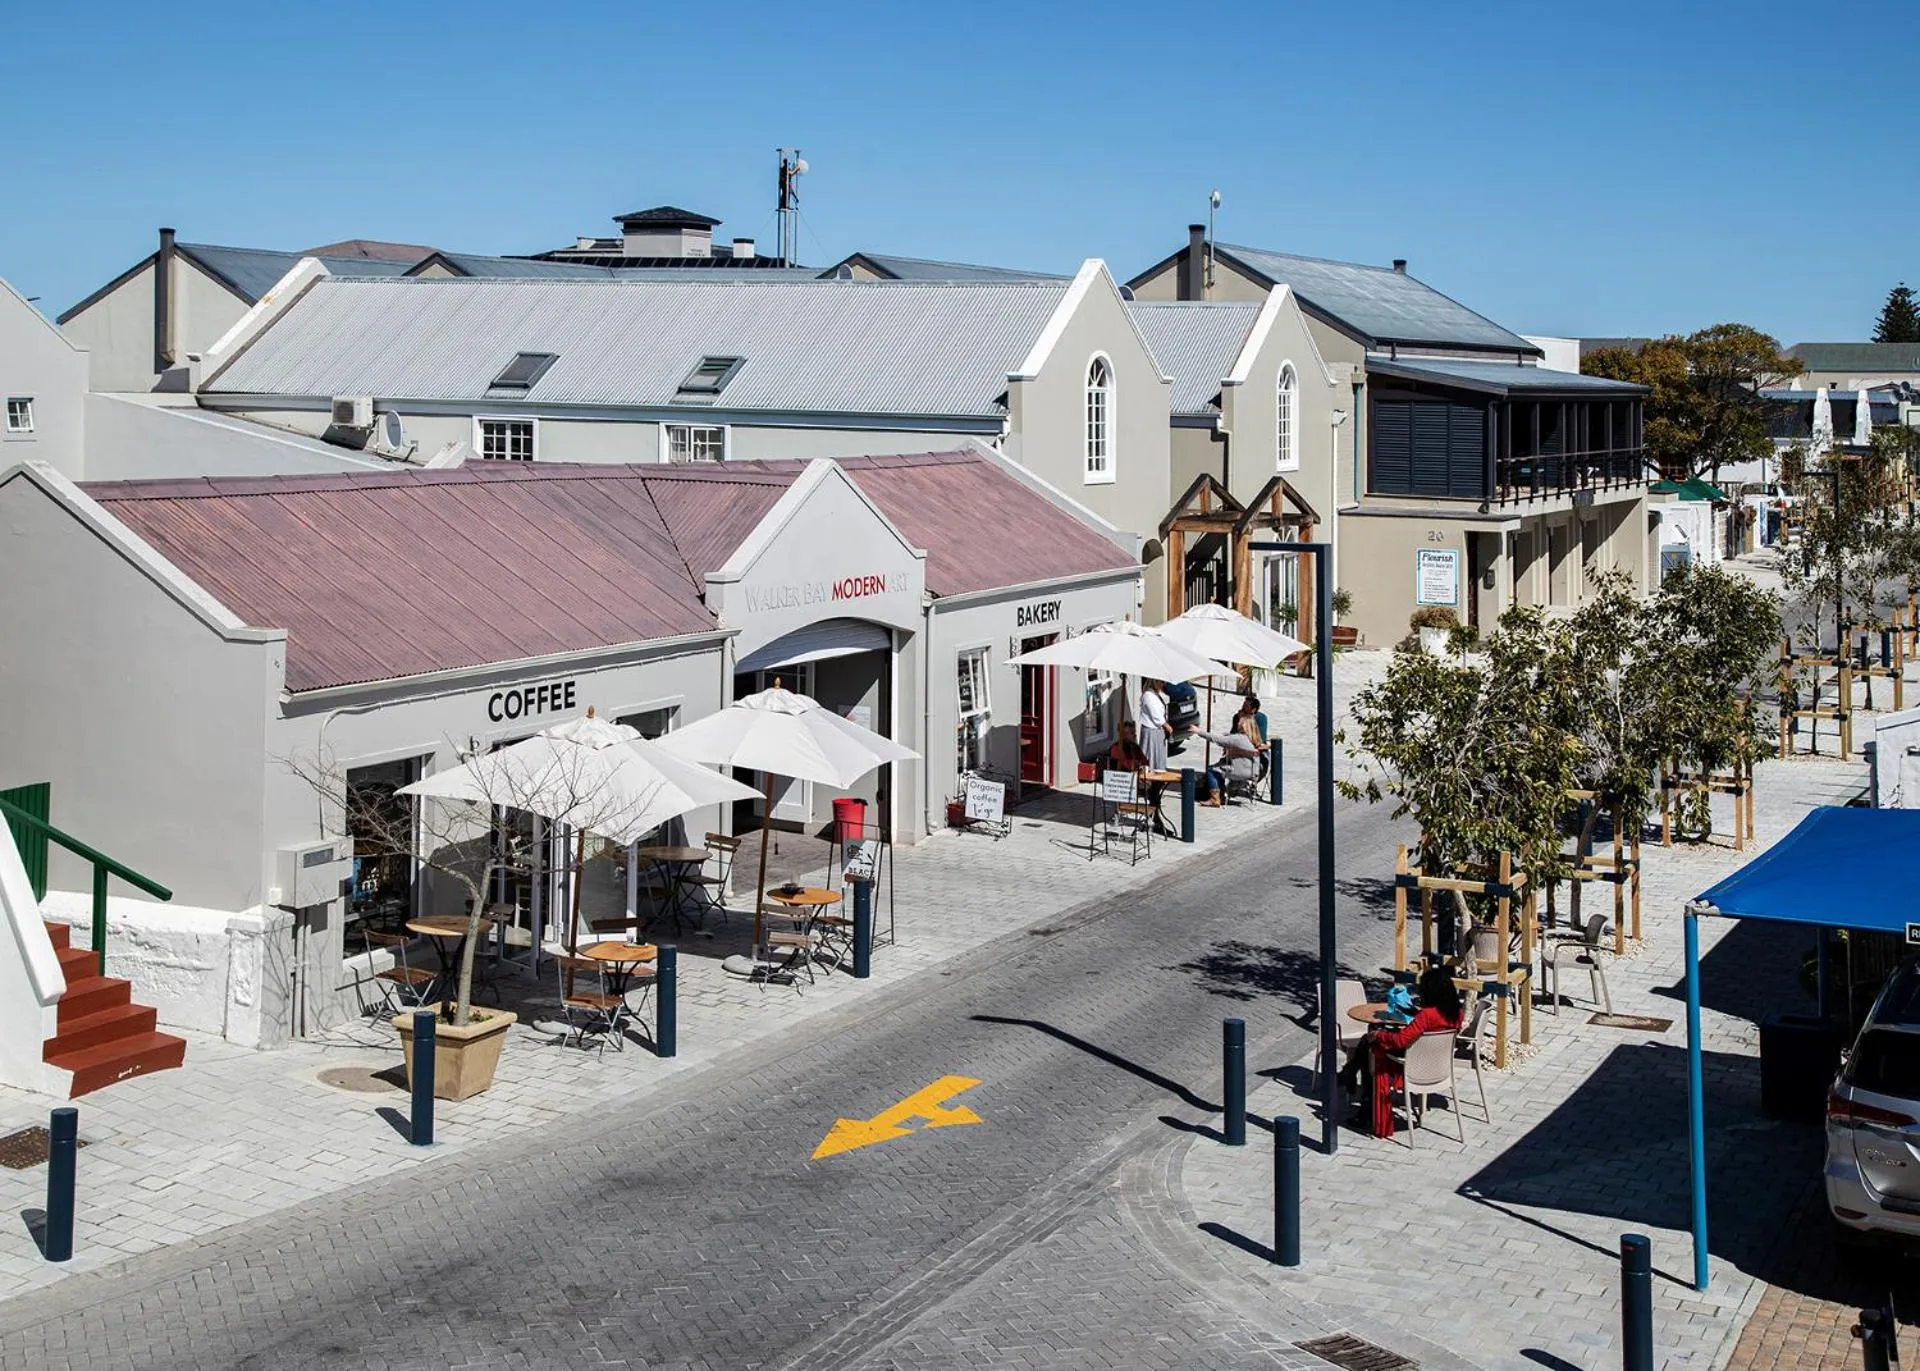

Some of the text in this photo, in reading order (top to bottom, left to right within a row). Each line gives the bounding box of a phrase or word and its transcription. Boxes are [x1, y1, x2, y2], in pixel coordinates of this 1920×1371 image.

[1428, 530, 1444, 542] 20
[831, 574, 886, 601] MODERN
[1017, 600, 1062, 627] BAKERY
[488, 681, 576, 722] COFFEE
[970, 781, 1002, 793] Organic
